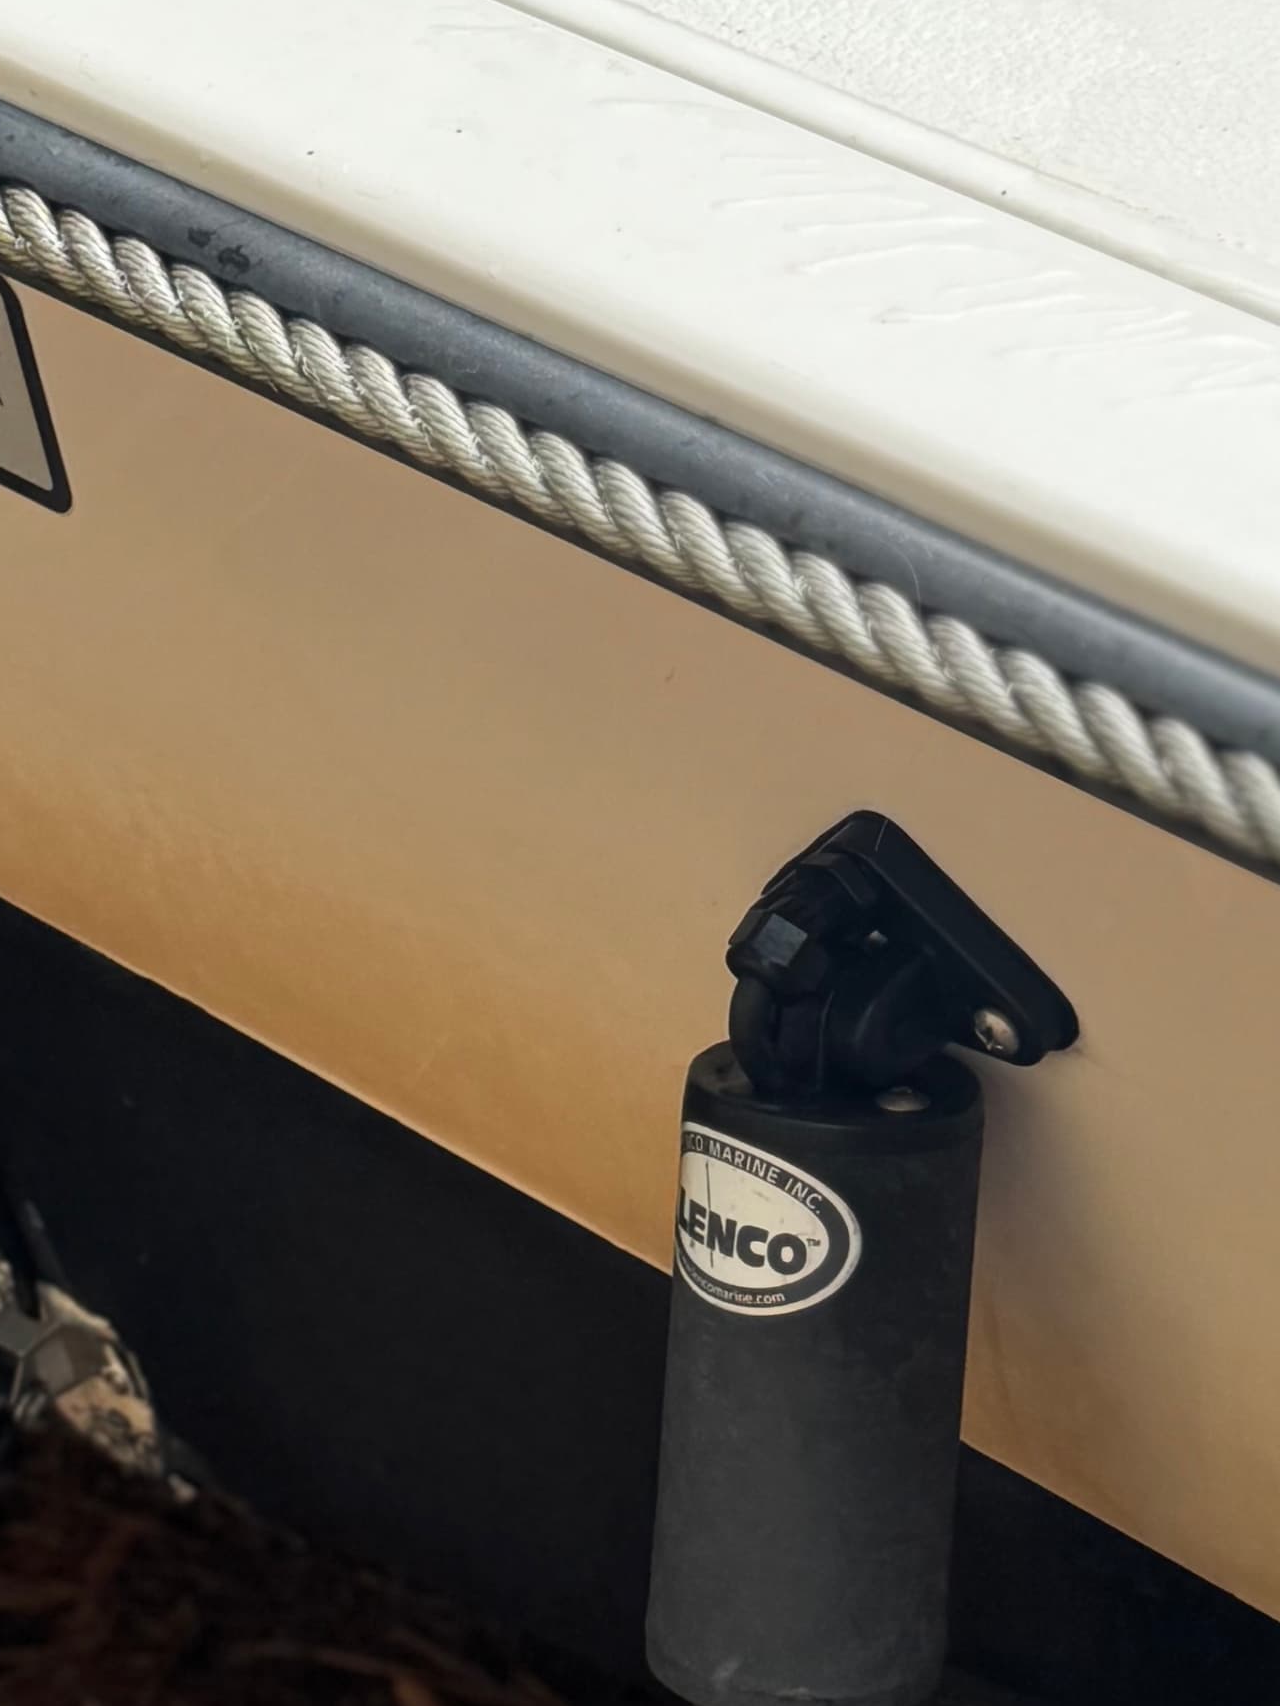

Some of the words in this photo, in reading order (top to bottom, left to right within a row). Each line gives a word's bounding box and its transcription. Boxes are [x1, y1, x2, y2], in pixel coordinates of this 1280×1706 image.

[709, 1140, 778, 1183] MARINE
[785, 1177, 822, 1214] INC.
[677, 1185, 807, 1275] LENCO
